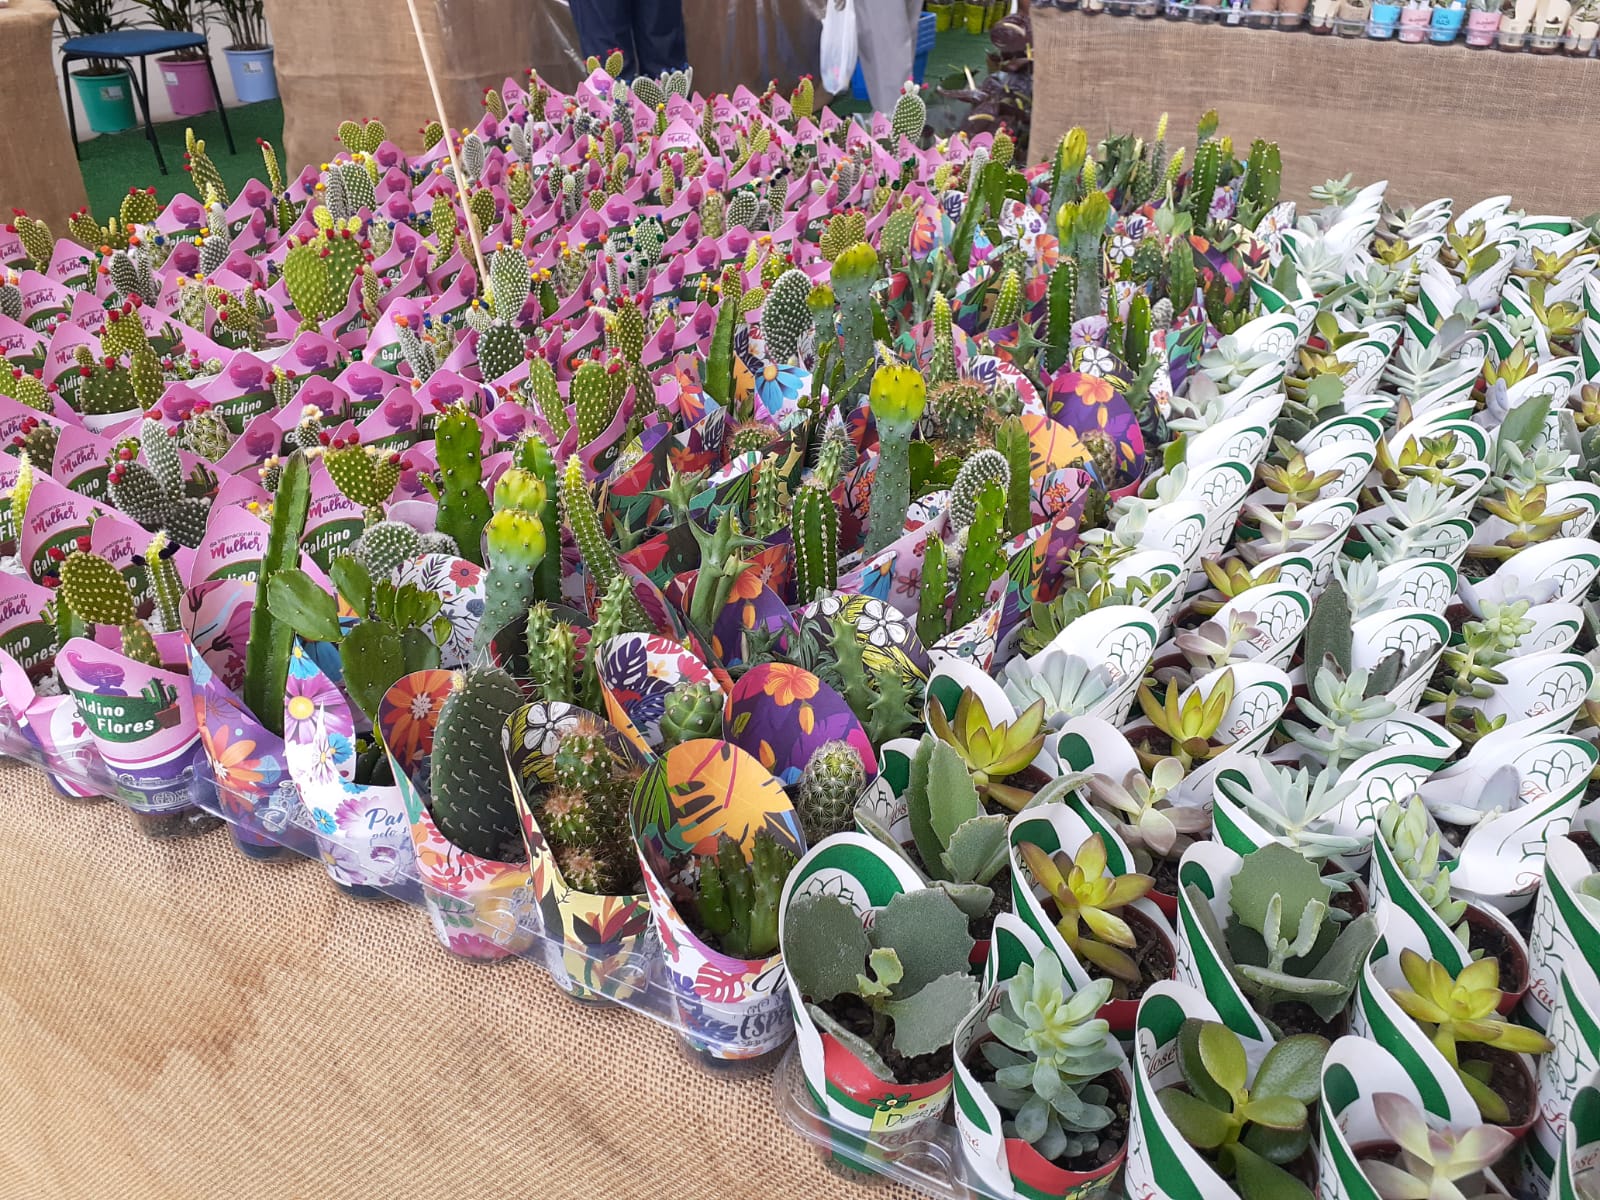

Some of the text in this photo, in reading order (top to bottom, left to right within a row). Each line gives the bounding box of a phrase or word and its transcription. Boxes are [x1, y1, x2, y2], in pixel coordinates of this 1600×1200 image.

[213, 400, 262, 416] Galdino
[61, 448, 99, 475] Mulher
[309, 497, 355, 519] Mulher
[32, 506, 78, 536] Mulher
[210, 536, 262, 560] Mulher
[97, 718, 155, 735] Flores
